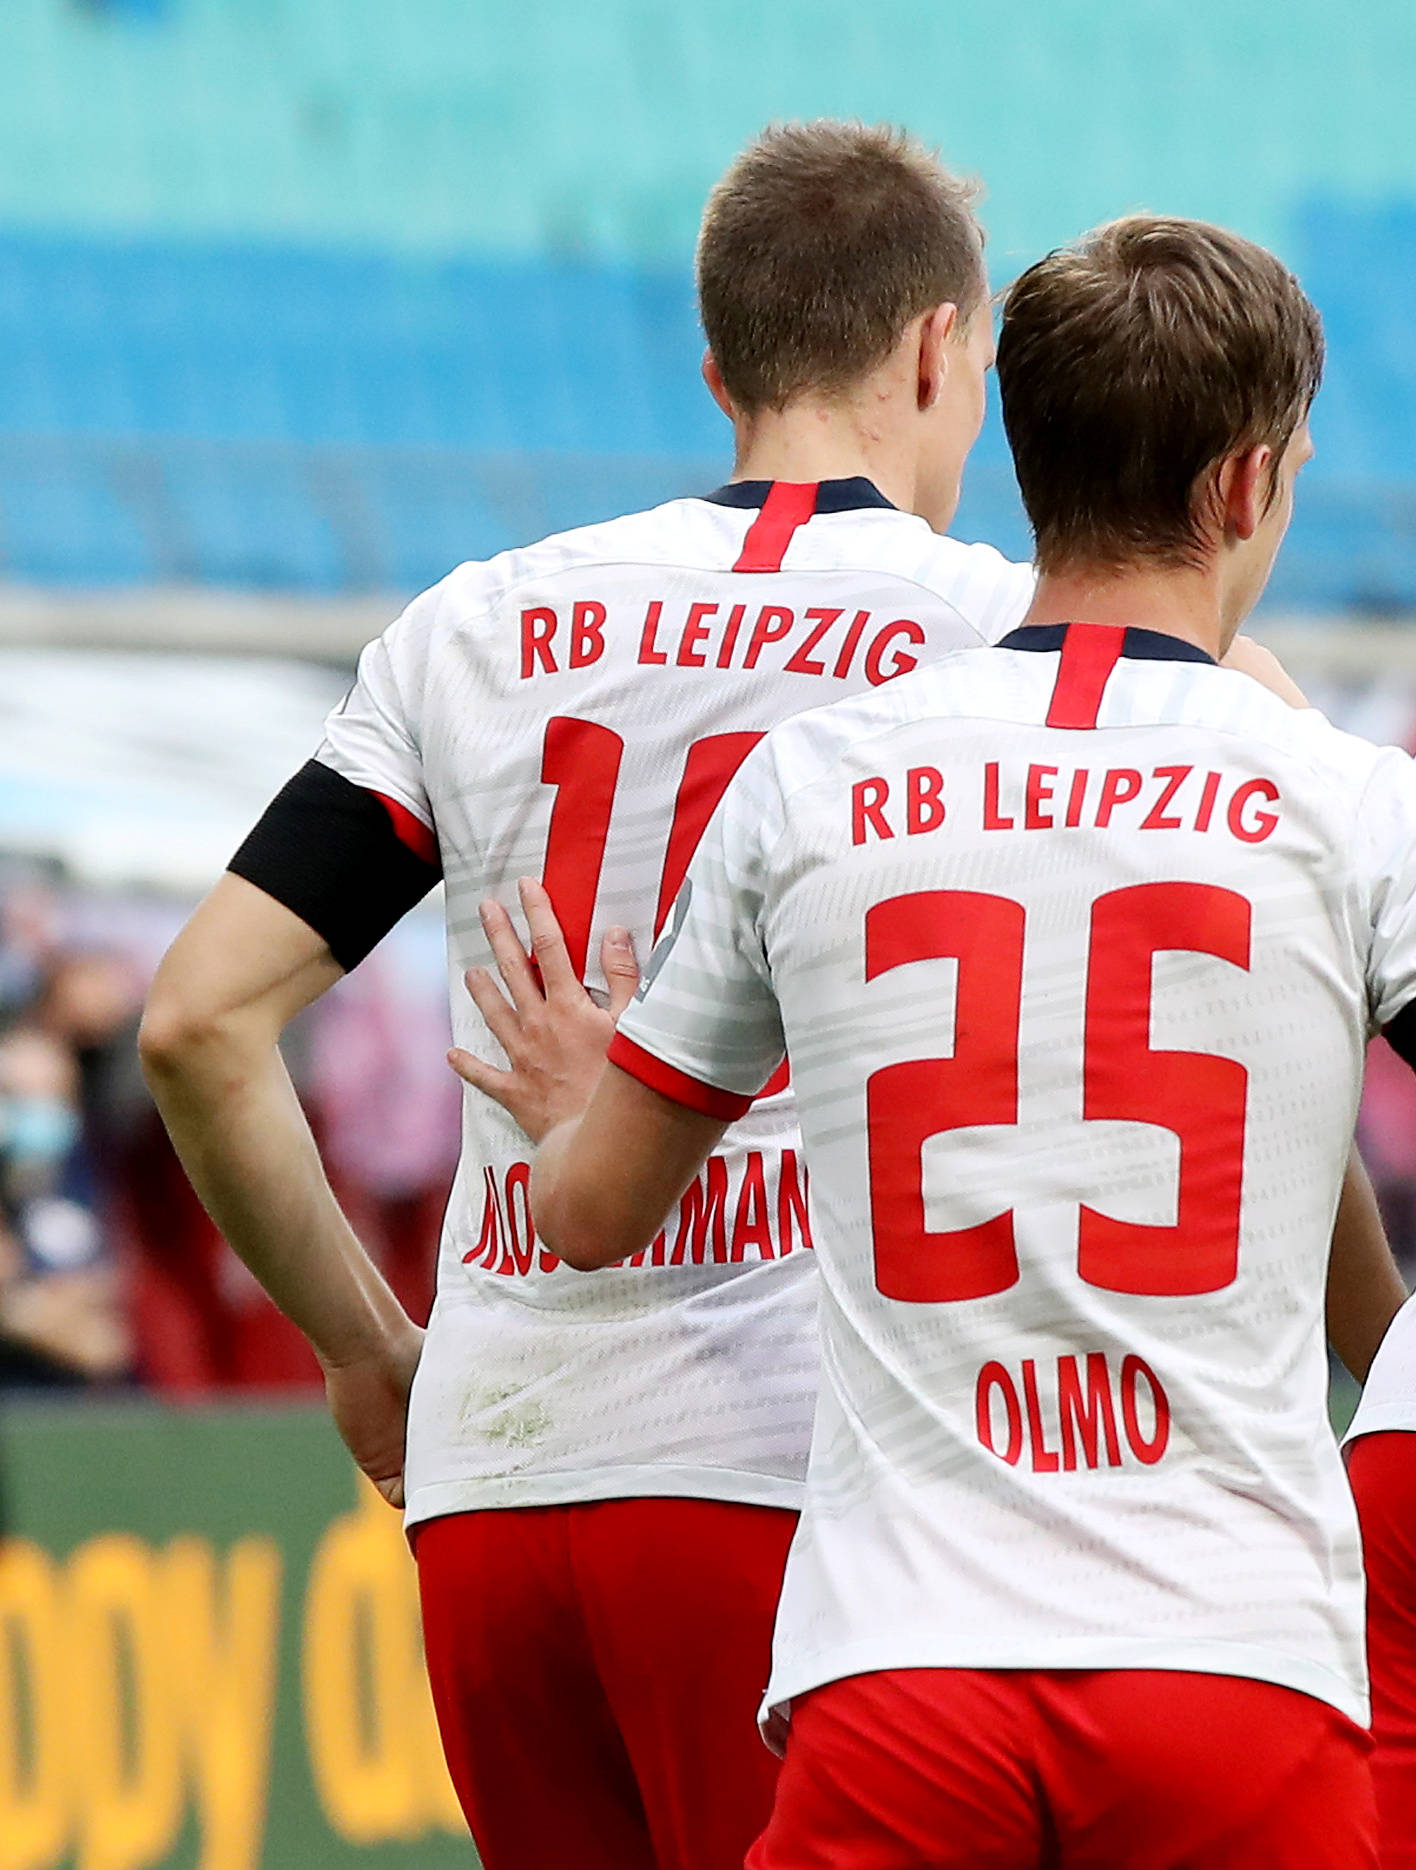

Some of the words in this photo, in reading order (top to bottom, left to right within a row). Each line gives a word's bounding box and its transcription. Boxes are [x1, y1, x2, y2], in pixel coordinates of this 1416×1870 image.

[520, 600, 607, 680] RB
[637, 600, 927, 688] LEIPZIG
[851, 765, 946, 846] RB
[983, 762, 1280, 844] LEIPZIG
[865, 880, 1252, 1304] 25
[975, 1351, 1170, 1474] OLMO
